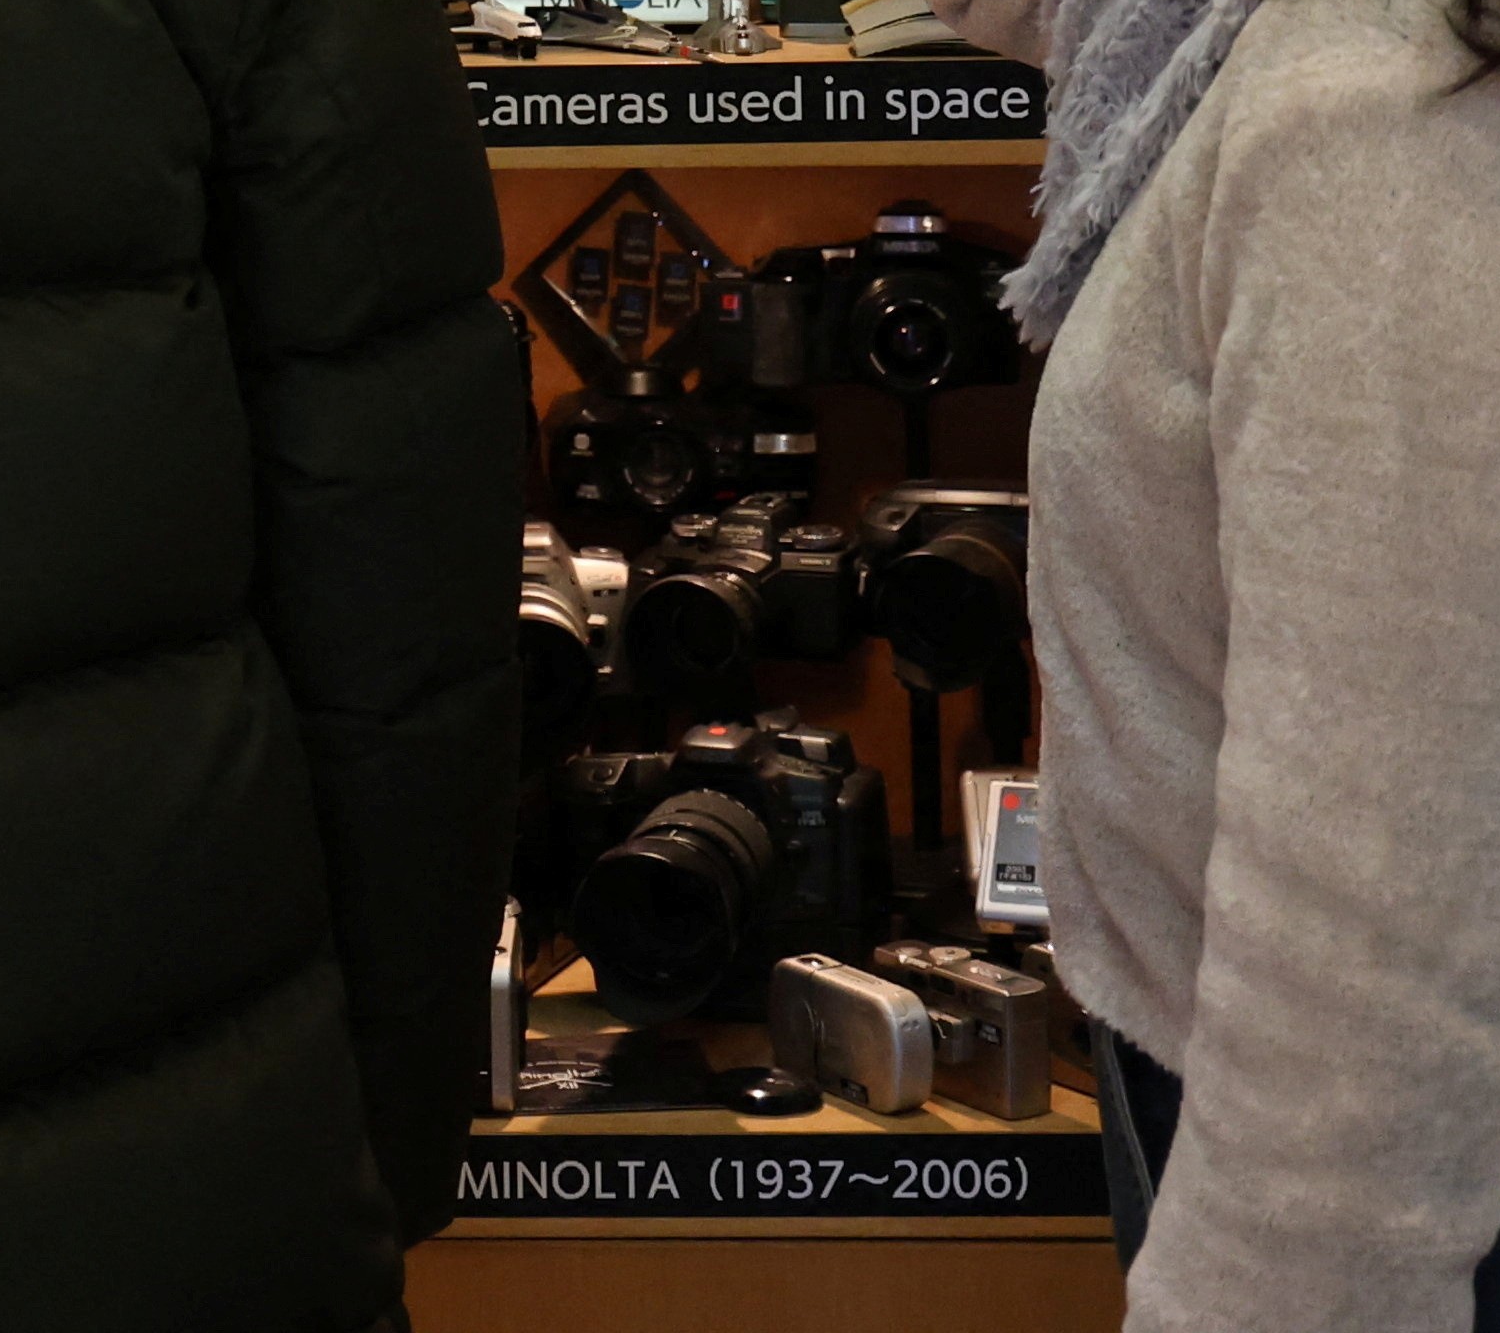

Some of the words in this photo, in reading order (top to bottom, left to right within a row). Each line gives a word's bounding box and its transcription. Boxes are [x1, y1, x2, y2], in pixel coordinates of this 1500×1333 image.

[688, 75, 803, 125] used
[824, 76, 867, 121] in
[885, 84, 1032, 136] space
[457, 1159, 680, 1202] MINOLTA
